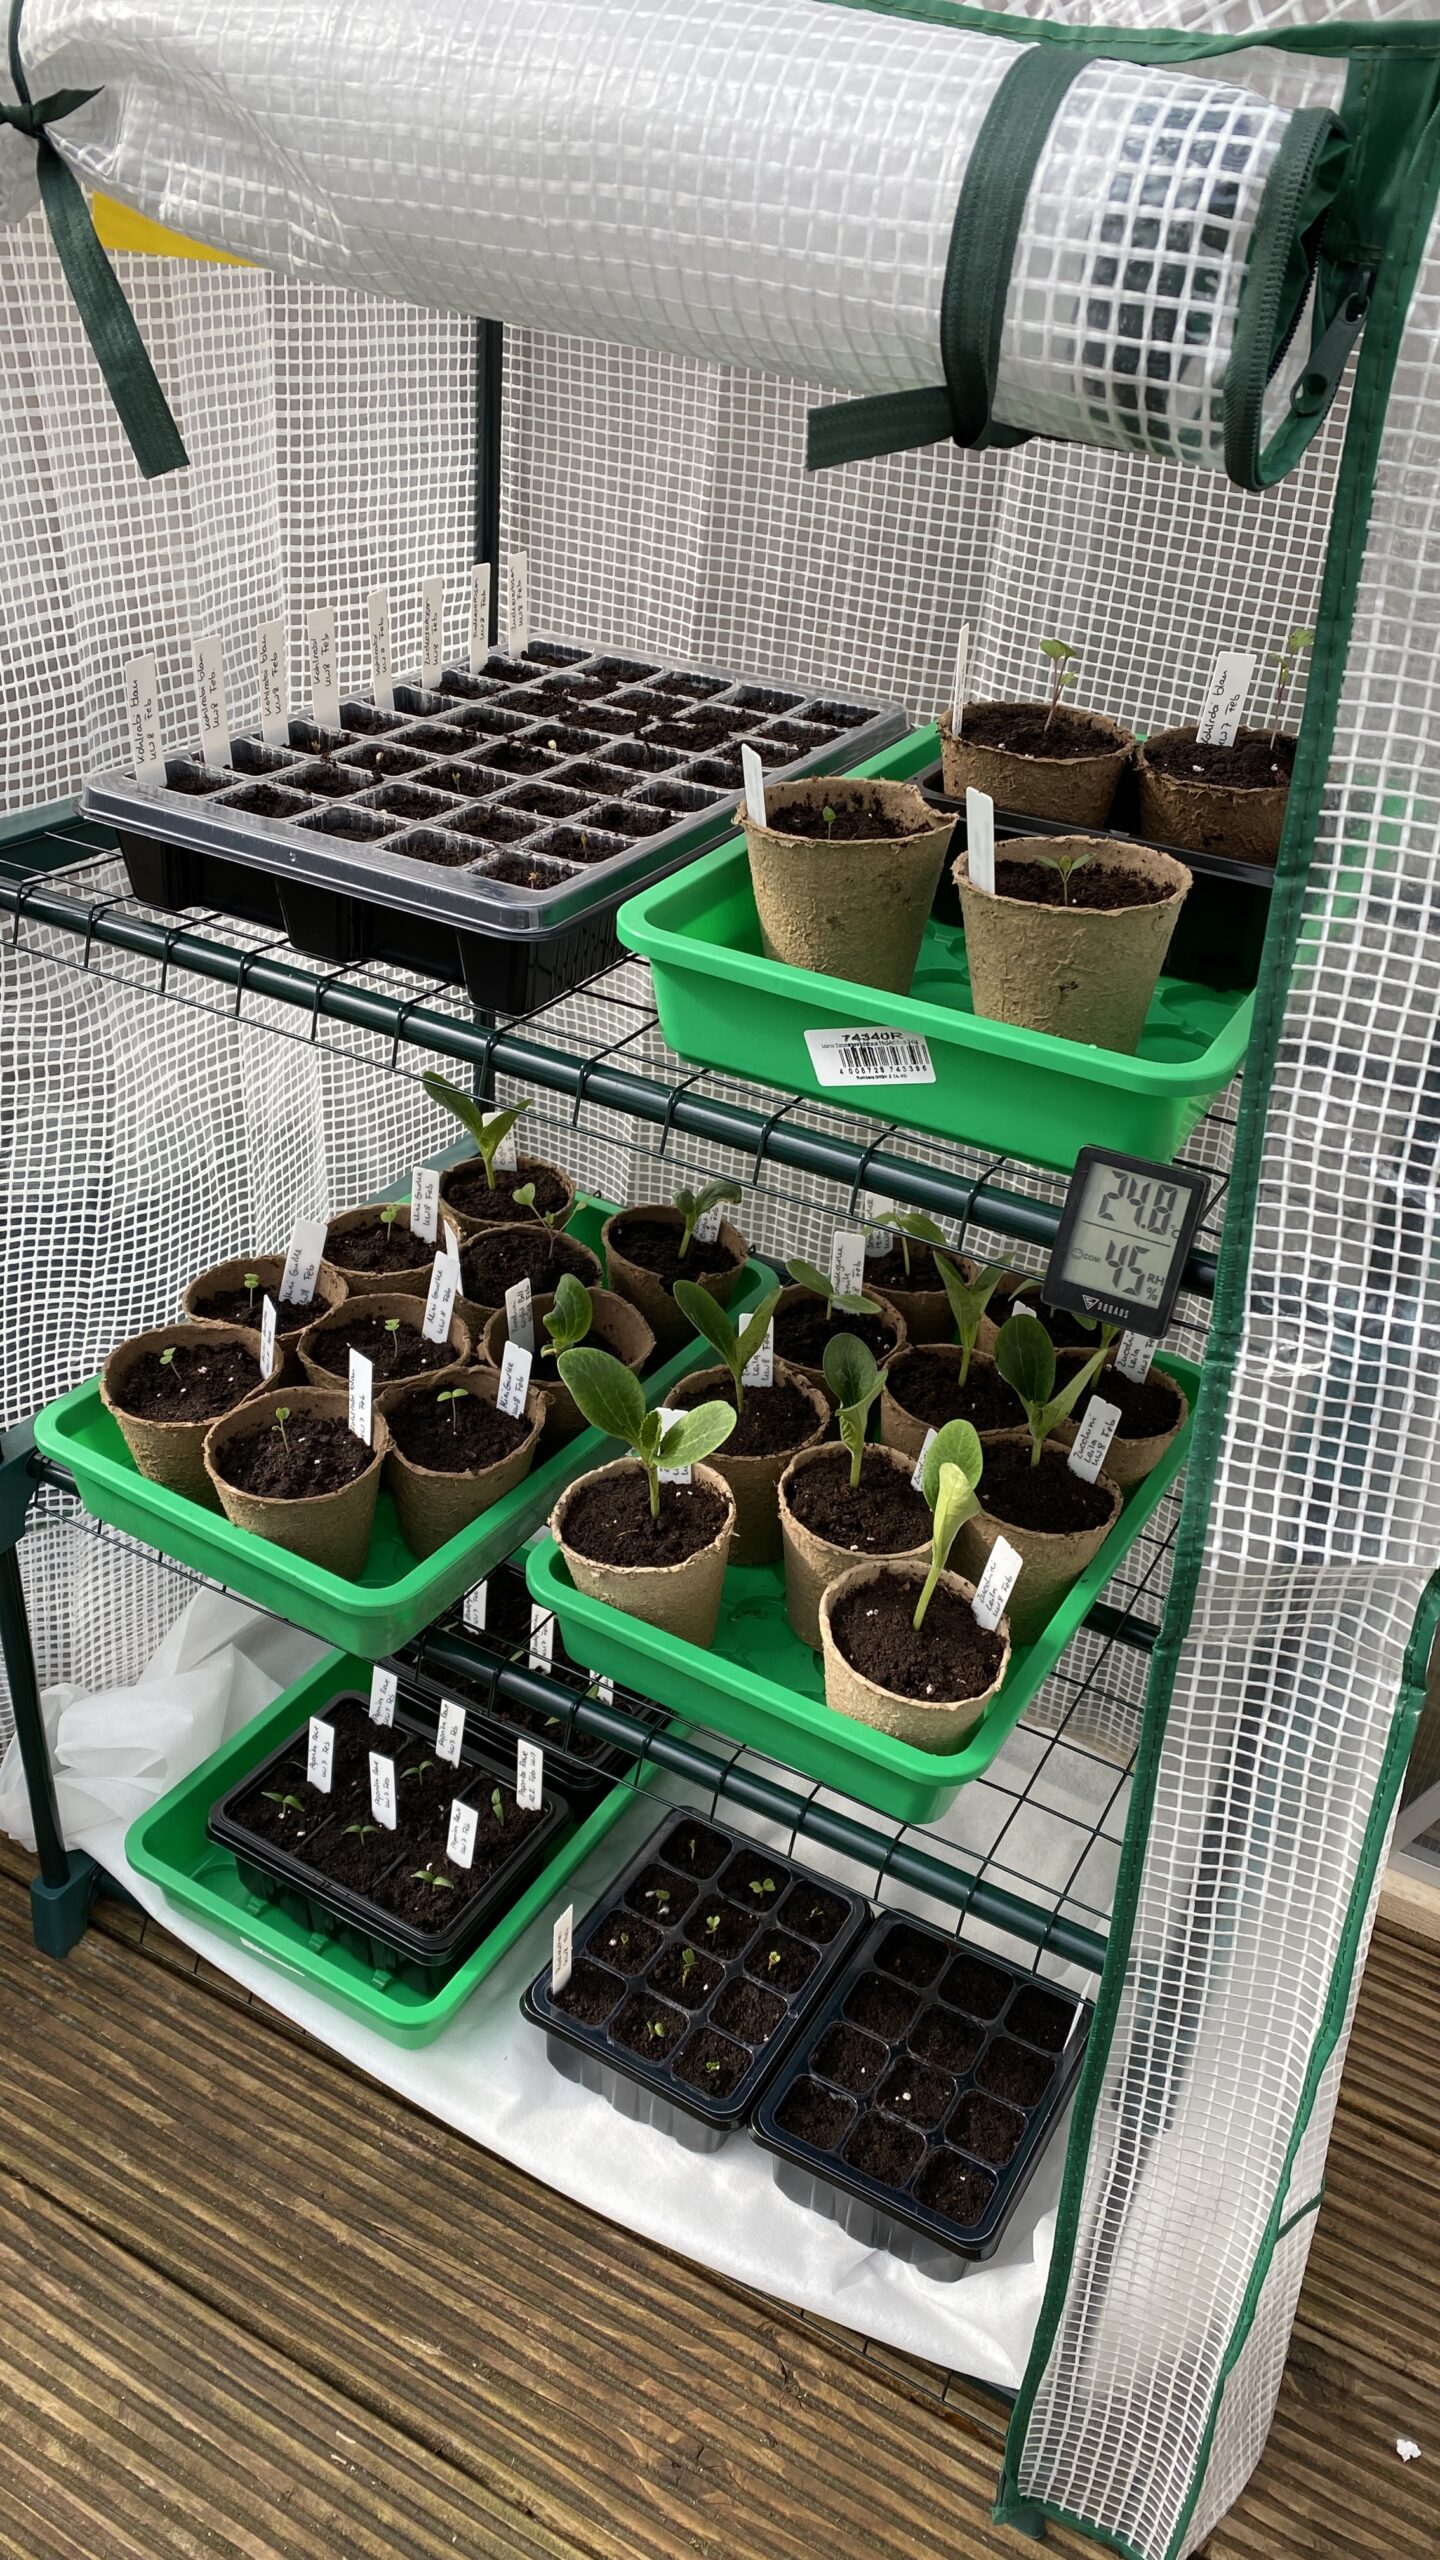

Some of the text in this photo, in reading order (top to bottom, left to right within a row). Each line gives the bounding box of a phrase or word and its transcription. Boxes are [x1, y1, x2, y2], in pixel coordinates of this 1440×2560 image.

[270, 652, 278, 677] Feb
[261, 669, 272, 717] Kohlrabi
[1225, 694, 1241, 716] Feb
[144, 698, 152, 722] Feb
[199, 686, 211, 731] Kohlrabi
[132, 714, 145, 764] Kohlrabi
[841, 1032, 904, 1042] 74340R
[1098, 1170, 1178, 1236] 24.8
[304, 1264, 315, 1281] Feb
[1105, 1240, 1151, 1297] 45
[1101, 1419, 1116, 1438] Feb
